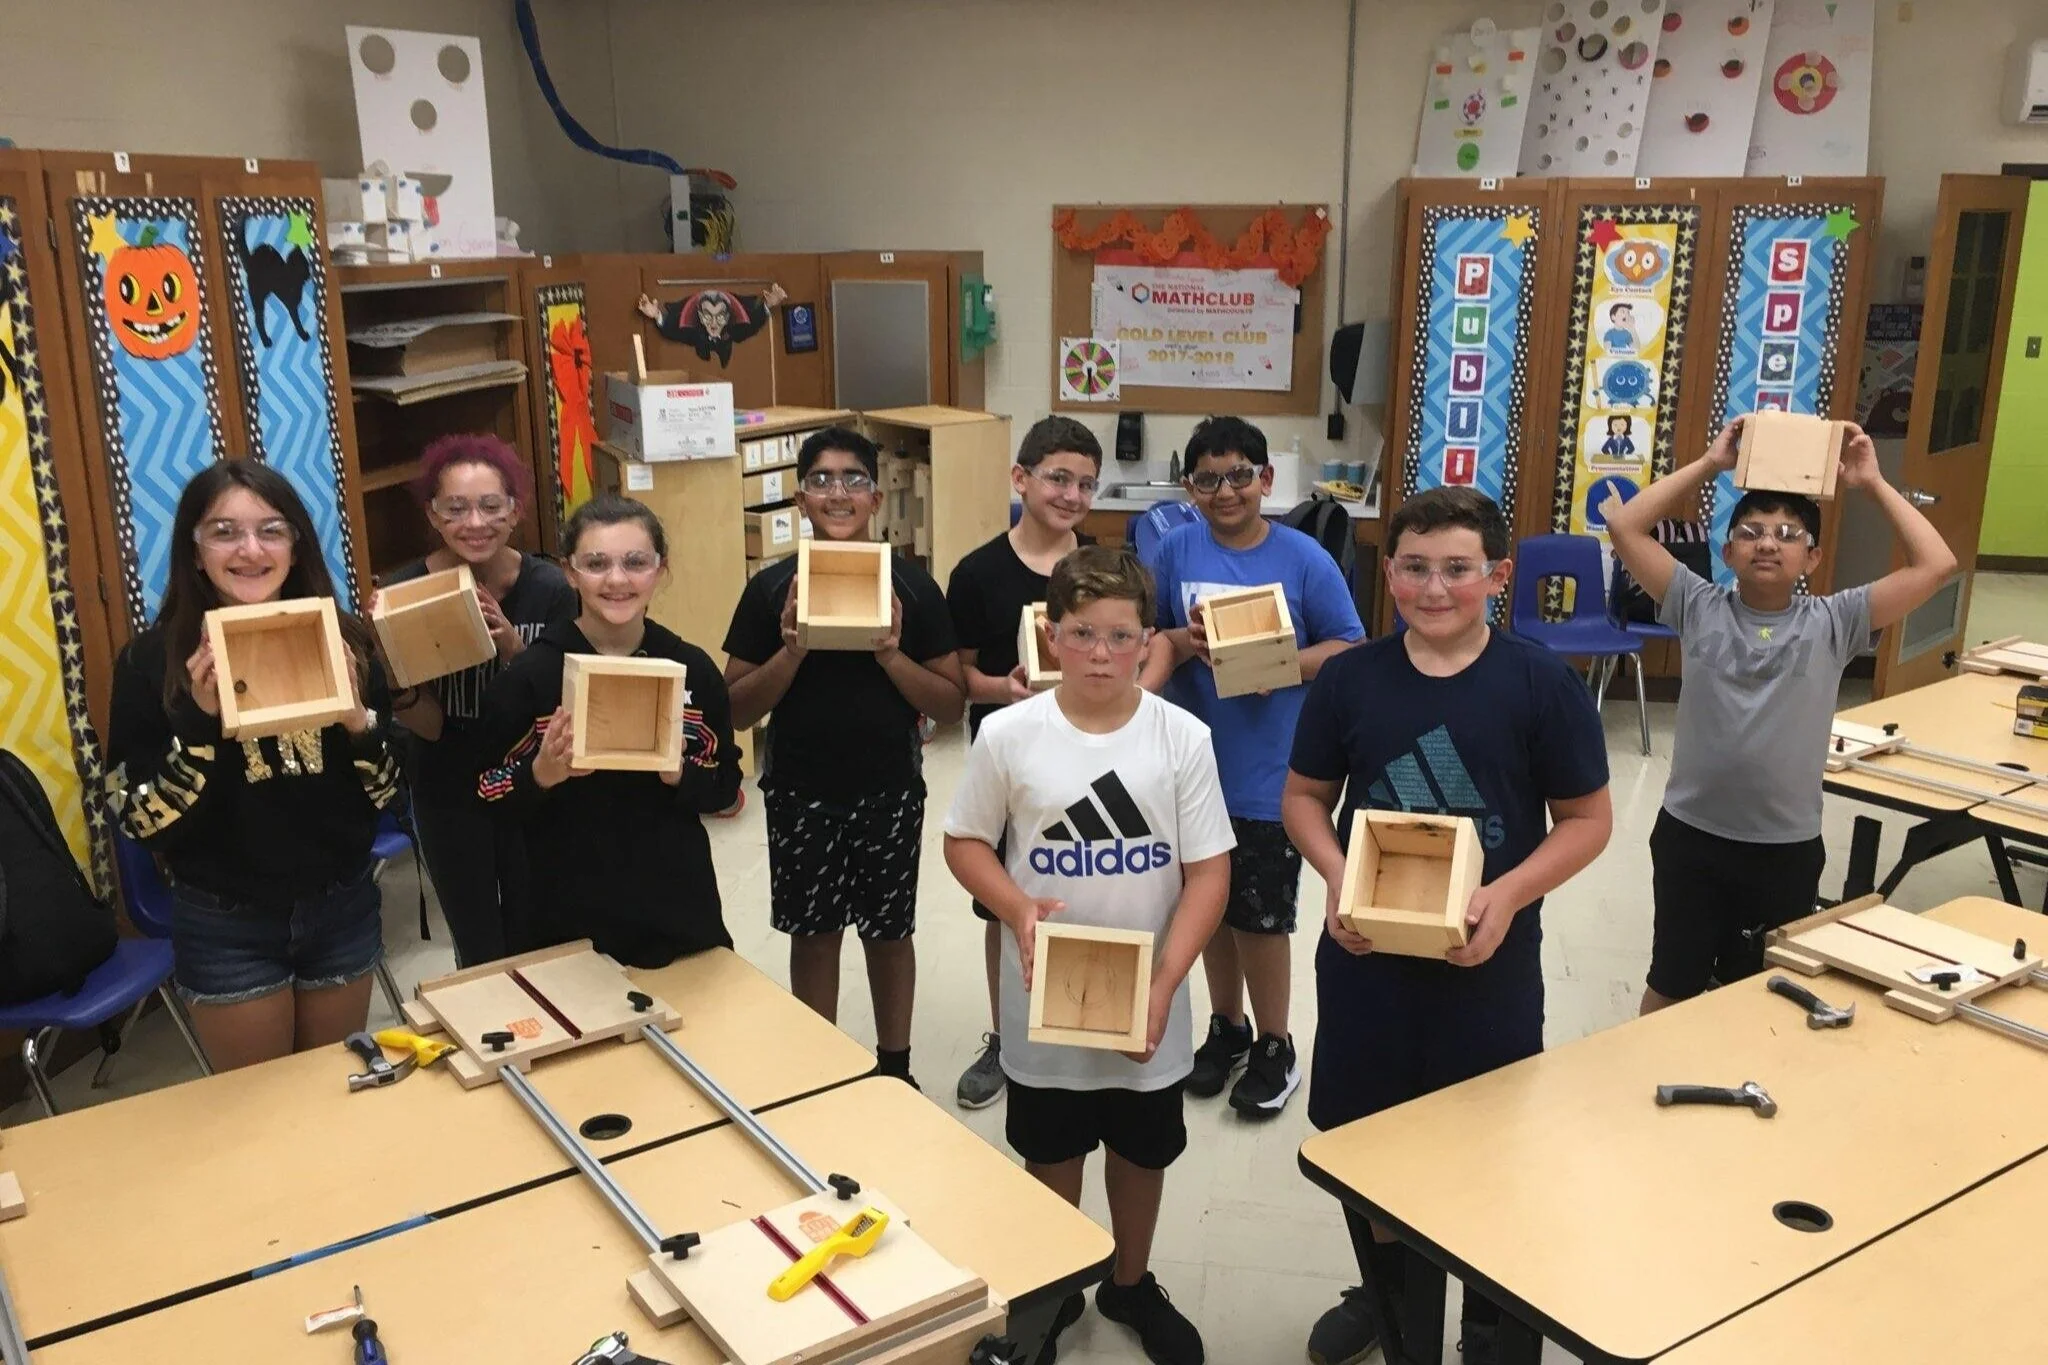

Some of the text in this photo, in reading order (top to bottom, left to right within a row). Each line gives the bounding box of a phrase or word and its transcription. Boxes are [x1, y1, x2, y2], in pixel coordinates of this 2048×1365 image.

[1152, 291, 1255, 306] MATHCLUB
[1197, 307, 1204, 315] by
[1117, 327, 1268, 344] GOLD LEVEL CLUB
[1148, 349, 1235, 364] 2017-2018
[1029, 838, 1172, 877] adidas
